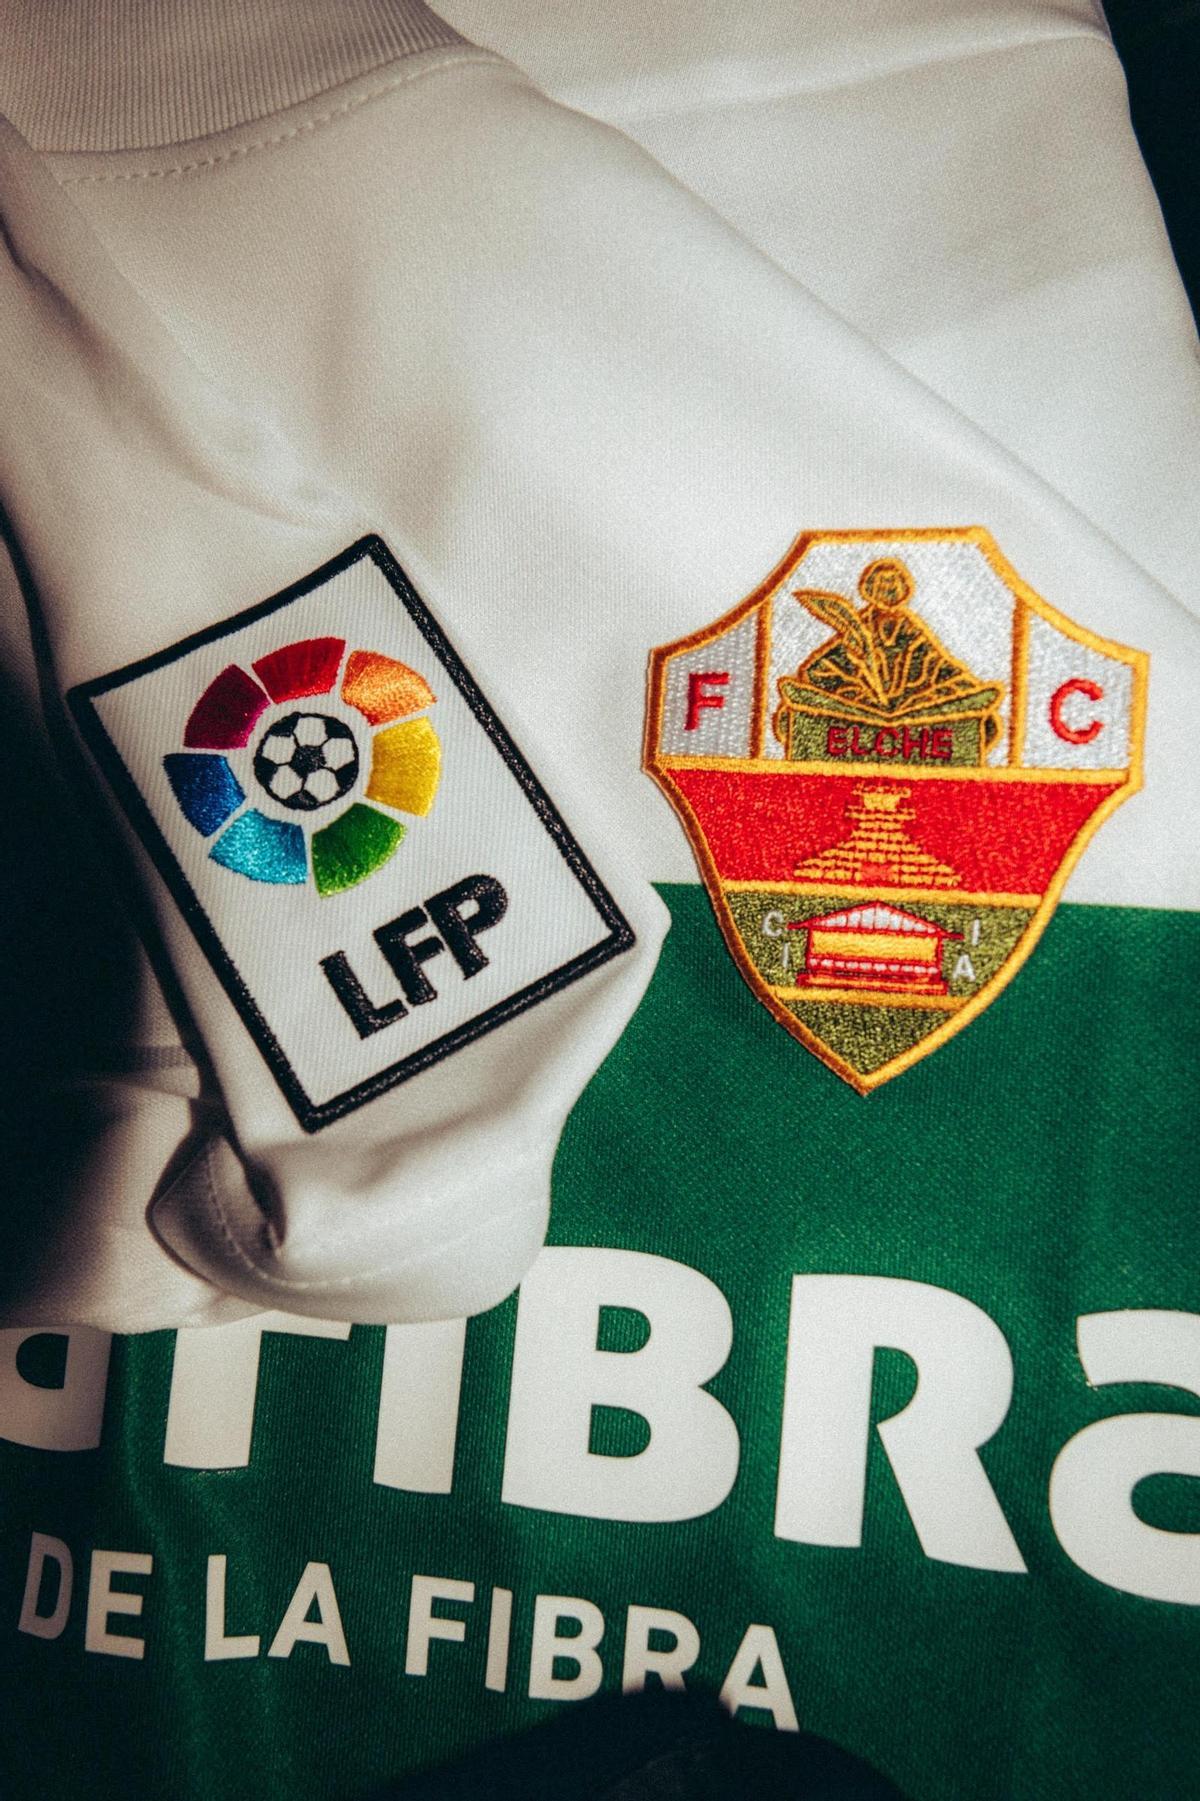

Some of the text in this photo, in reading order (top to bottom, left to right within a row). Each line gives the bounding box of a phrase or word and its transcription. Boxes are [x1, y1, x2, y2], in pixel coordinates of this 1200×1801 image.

[685, 672, 1105, 746] F C
[826, 725, 954, 760] ELCHE
[761, 909, 785, 937] C
[319, 874, 509, 1040] LFP
[952, 956, 976, 982] A
[18, 1531, 800, 1732] DE LA FIBRA
